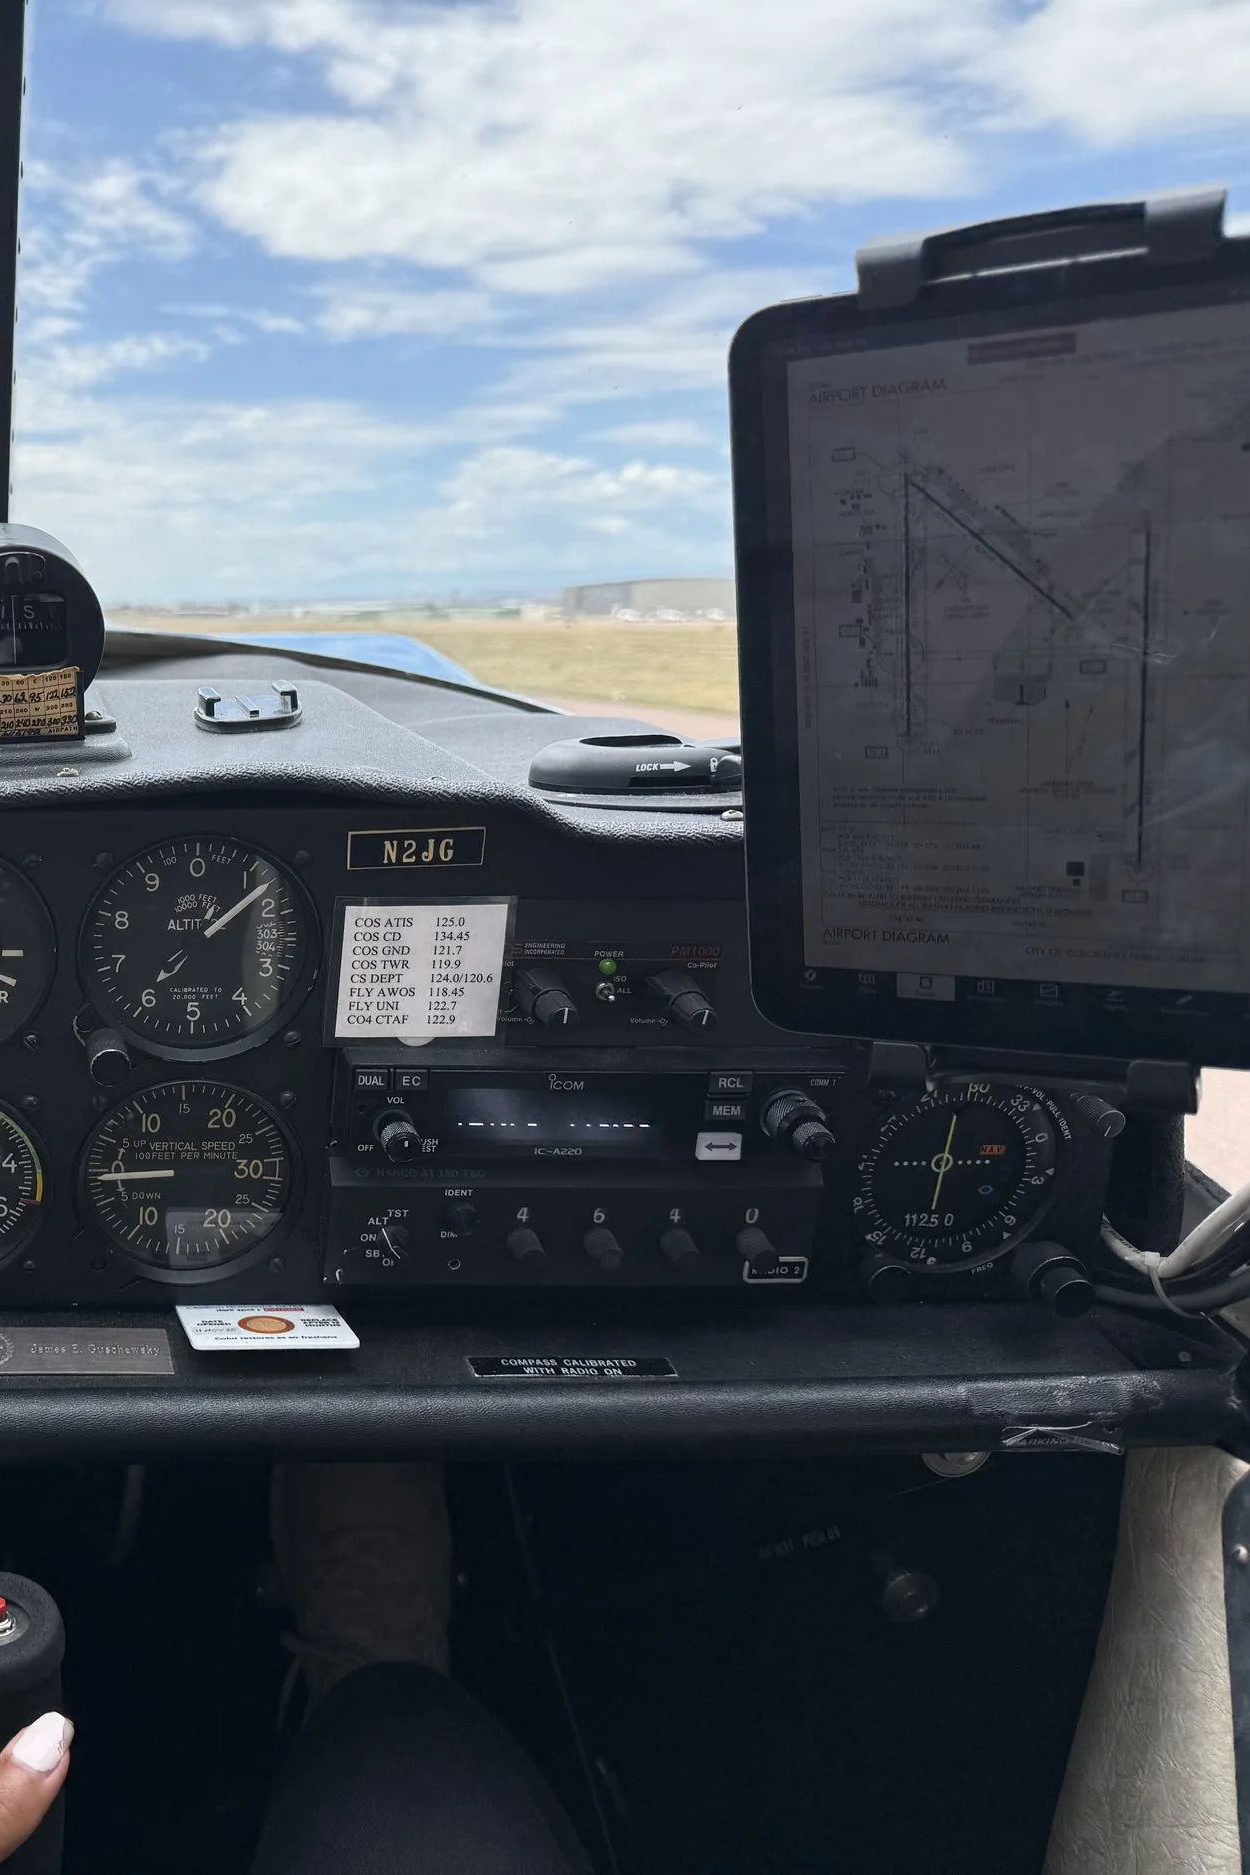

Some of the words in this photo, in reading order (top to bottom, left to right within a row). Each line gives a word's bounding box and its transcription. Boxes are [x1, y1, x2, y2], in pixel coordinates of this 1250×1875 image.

[807, 384, 868, 406] AIRPORT
[871, 377, 947, 399] DIAGRAM
[22, 604, 36, 620] S
[635, 763, 659, 773] LOCK
[382, 838, 455, 864] N2JG
[114, 910, 130, 930] 8
[355, 917, 382, 928] COS
[384, 917, 414, 928] ATIS
[435, 917, 466, 928] 125.0
[353, 931, 380, 942] COS
[382, 931, 402, 942] CD
[434, 931, 470, 942] 134.45
[822, 927, 878, 942] AIRPORT
[881, 929, 951, 945] DIAGRAM
[352, 945, 379, 956] COS
[381, 945, 411, 956] GND
[432, 945, 463, 956] 121.7
[524, 942, 566, 950] ENGINEERING
[670, 945, 721, 958] PM1000
[593, 950, 624, 958] POWER
[351, 959, 378, 970] COS
[381, 959, 410, 970] TWR
[431, 959, 462, 970] 119.9
[687, 962, 717, 970] Co-Pilot
[350, 973, 367, 984] CS
[370, 973, 404, 984] DEPT
[430, 973, 494, 984] 124.0/120.6
[231, 986, 248, 1006] 4
[349, 987, 375, 998] FLY
[376, 987, 416, 998] AWOS
[429, 987, 465, 998] 118.45
[349, 1000, 373, 1011] FLY
[375, 1000, 400, 1011] UNI
[427, 1000, 457, 1011] 122.7
[347, 1014, 371, 1025] CO4
[375, 1014, 409, 1025] CTAF
[426, 1014, 456, 1025] 122.9
[630, 1017, 655, 1025] Volume
[357, 1075, 386, 1086] DUAL
[401, 1075, 422, 1086] EC
[717, 1077, 745, 1088] RCL
[386, 1096, 405, 1104] VOL
[712, 1105, 741, 1116] MEM
[121, 1137, 130, 1149] 5
[133, 1139, 147, 1148] UP
[150, 1141, 195, 1151] VERTICAL
[201, 1141, 236, 1150] SPEED
[357, 1144, 374, 1152] OFF
[180, 1151, 201, 1160] PER
[203, 1151, 239, 1160] MINUTE
[533, 1147, 583, 1157] IC-A220
[233, 1159, 263, 1180] 30
[420, 1168, 434, 1178] AT
[120, 1191, 129, 1202] 5
[131, 1191, 161, 1201] DOWN
[444, 1189, 474, 1197] IDENT
[387, 1209, 410, 1218] TST
[516, 1206, 530, 1223] 4
[592, 1206, 606, 1224] 6
[669, 1207, 682, 1224] 4
[744, 1207, 760, 1225] 0
[367, 1216, 390, 1226] ALT
[173, 1223, 186, 1235] 15
[360, 1234, 377, 1242] ON
[30, 1343, 67, 1354] James
[501, 1359, 559, 1367] COMPASS
[563, 1359, 638, 1368] CALIBRATED
[523, 1367, 555, 1375] WITH
[560, 1367, 599, 1375] RADIO
[604, 1368, 624, 1376] ON
